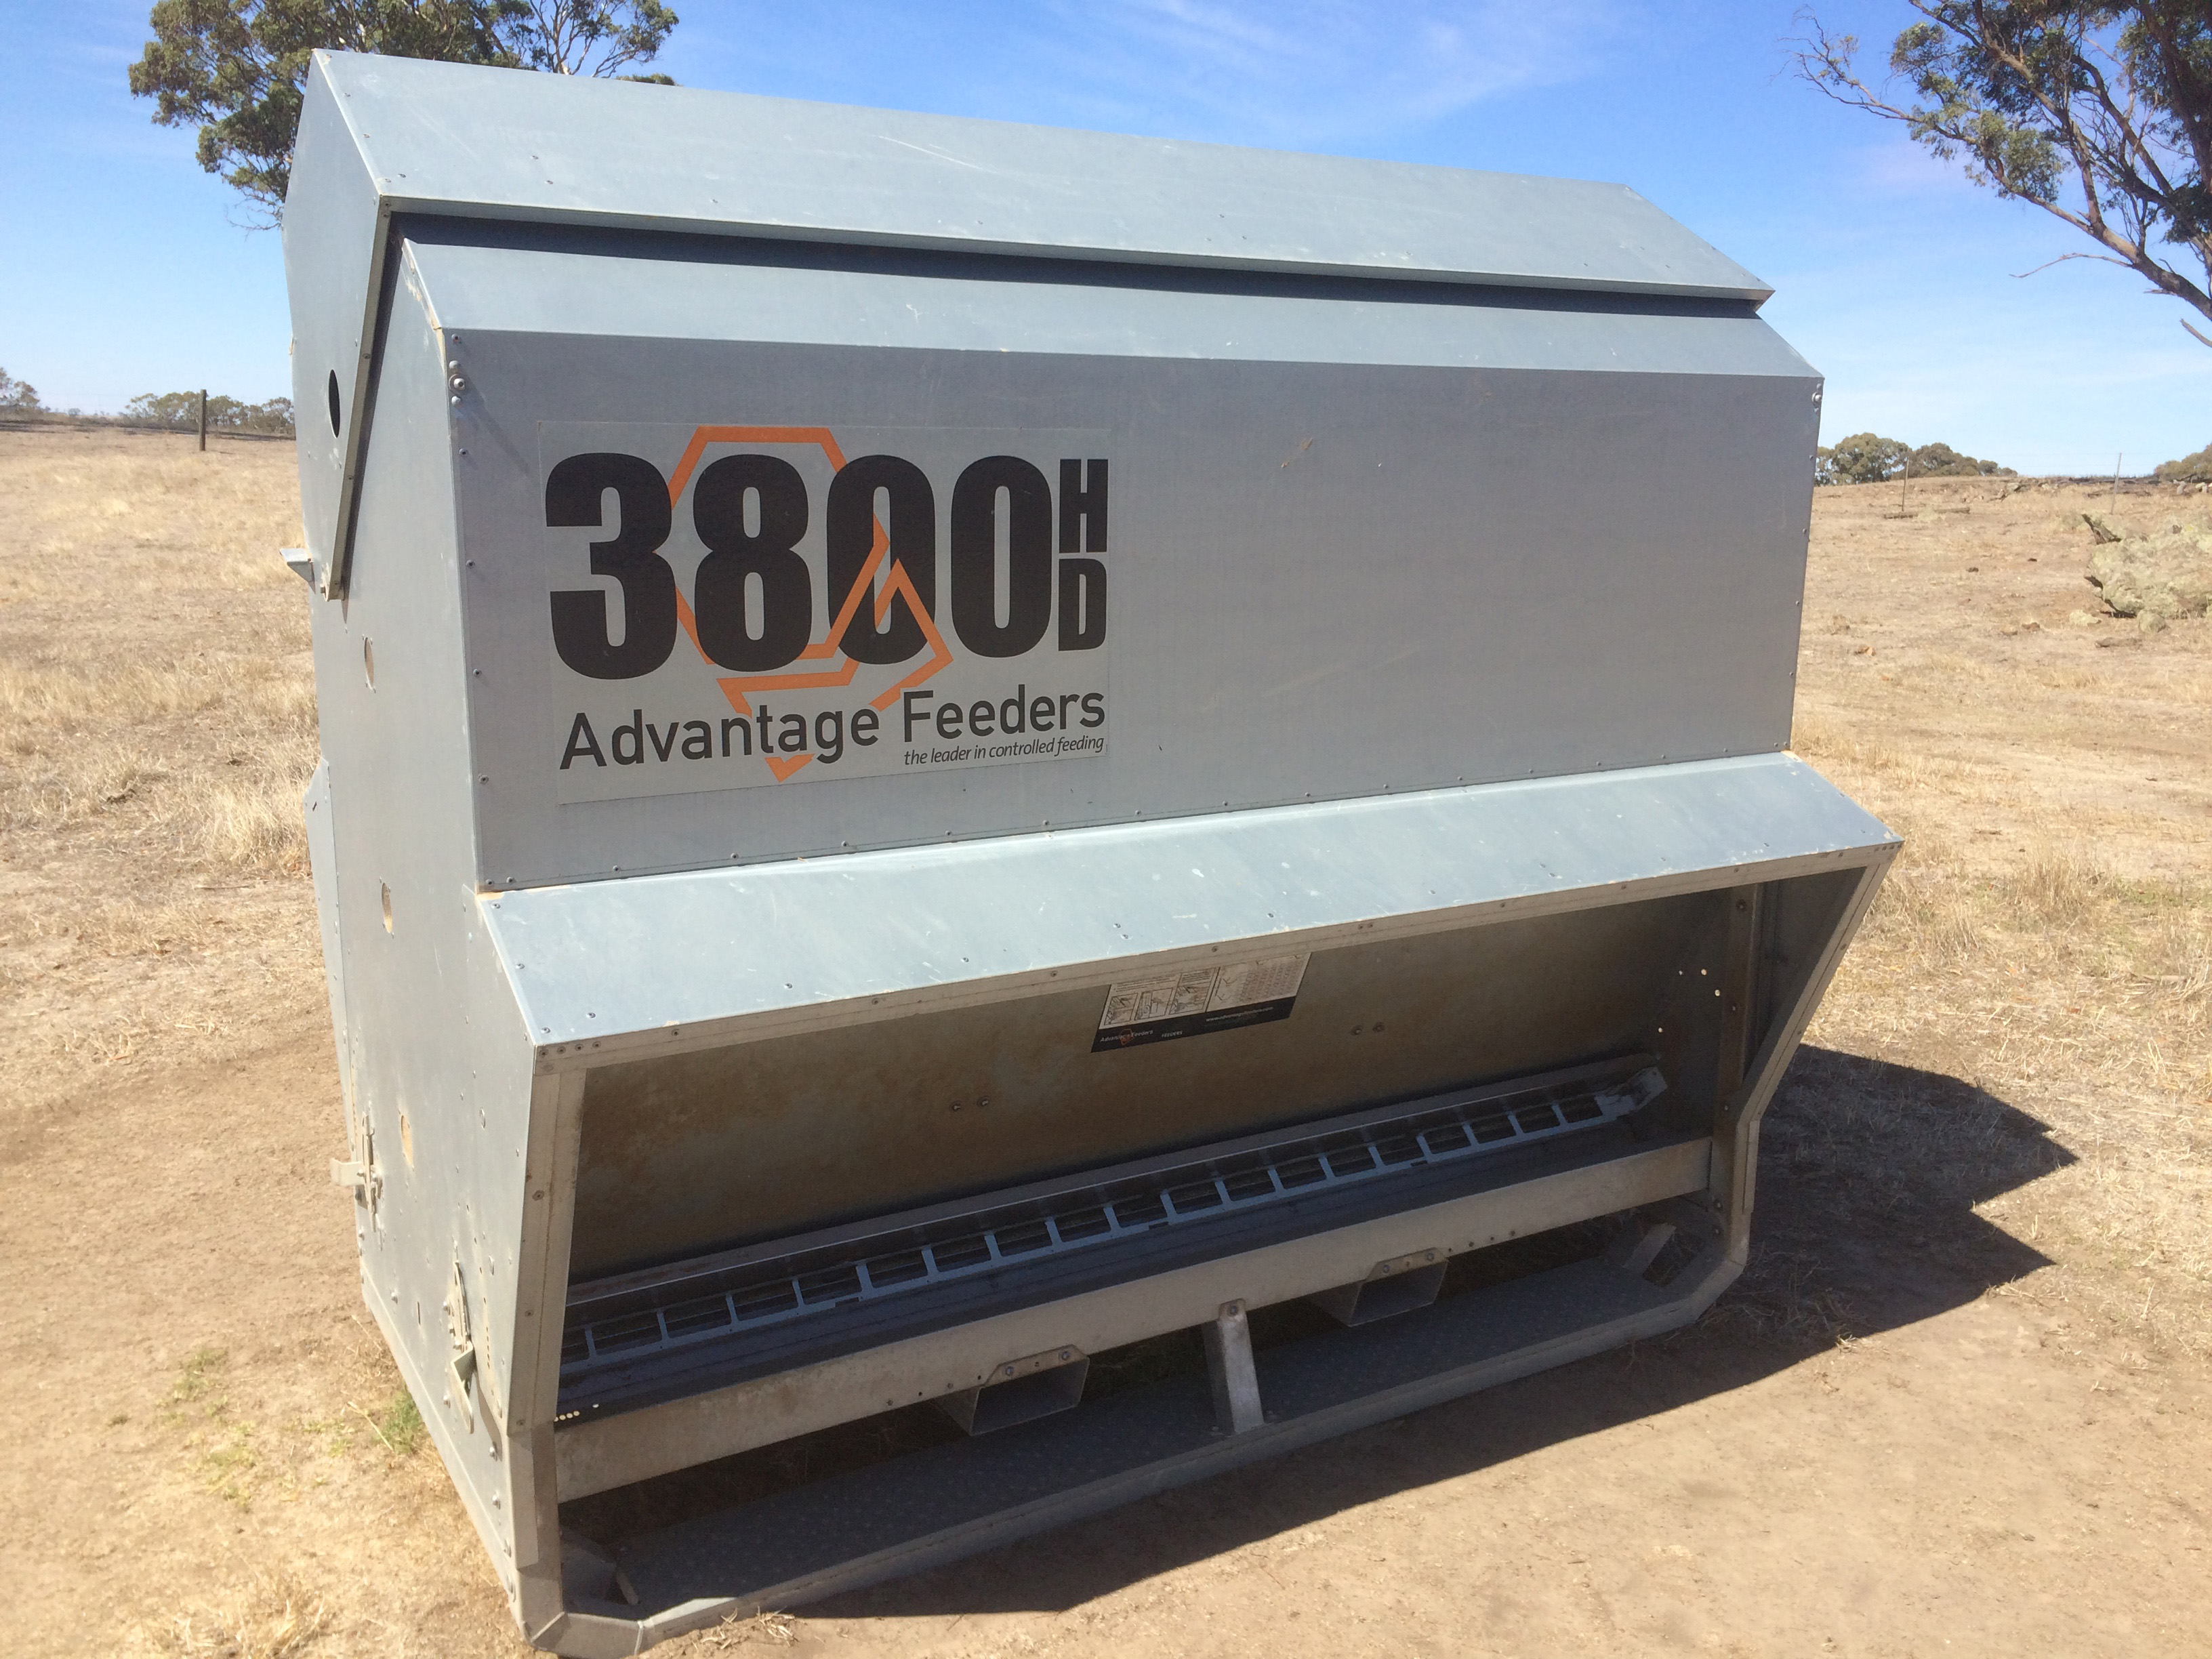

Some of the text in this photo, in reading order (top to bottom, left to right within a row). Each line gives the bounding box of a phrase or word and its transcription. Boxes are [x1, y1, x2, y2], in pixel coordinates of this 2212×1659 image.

[545, 452, 1052, 680] 3800
[559, 684, 1105, 770] Advantage Feeders
[904, 735, 1105, 765] the leader in controlled feeding
